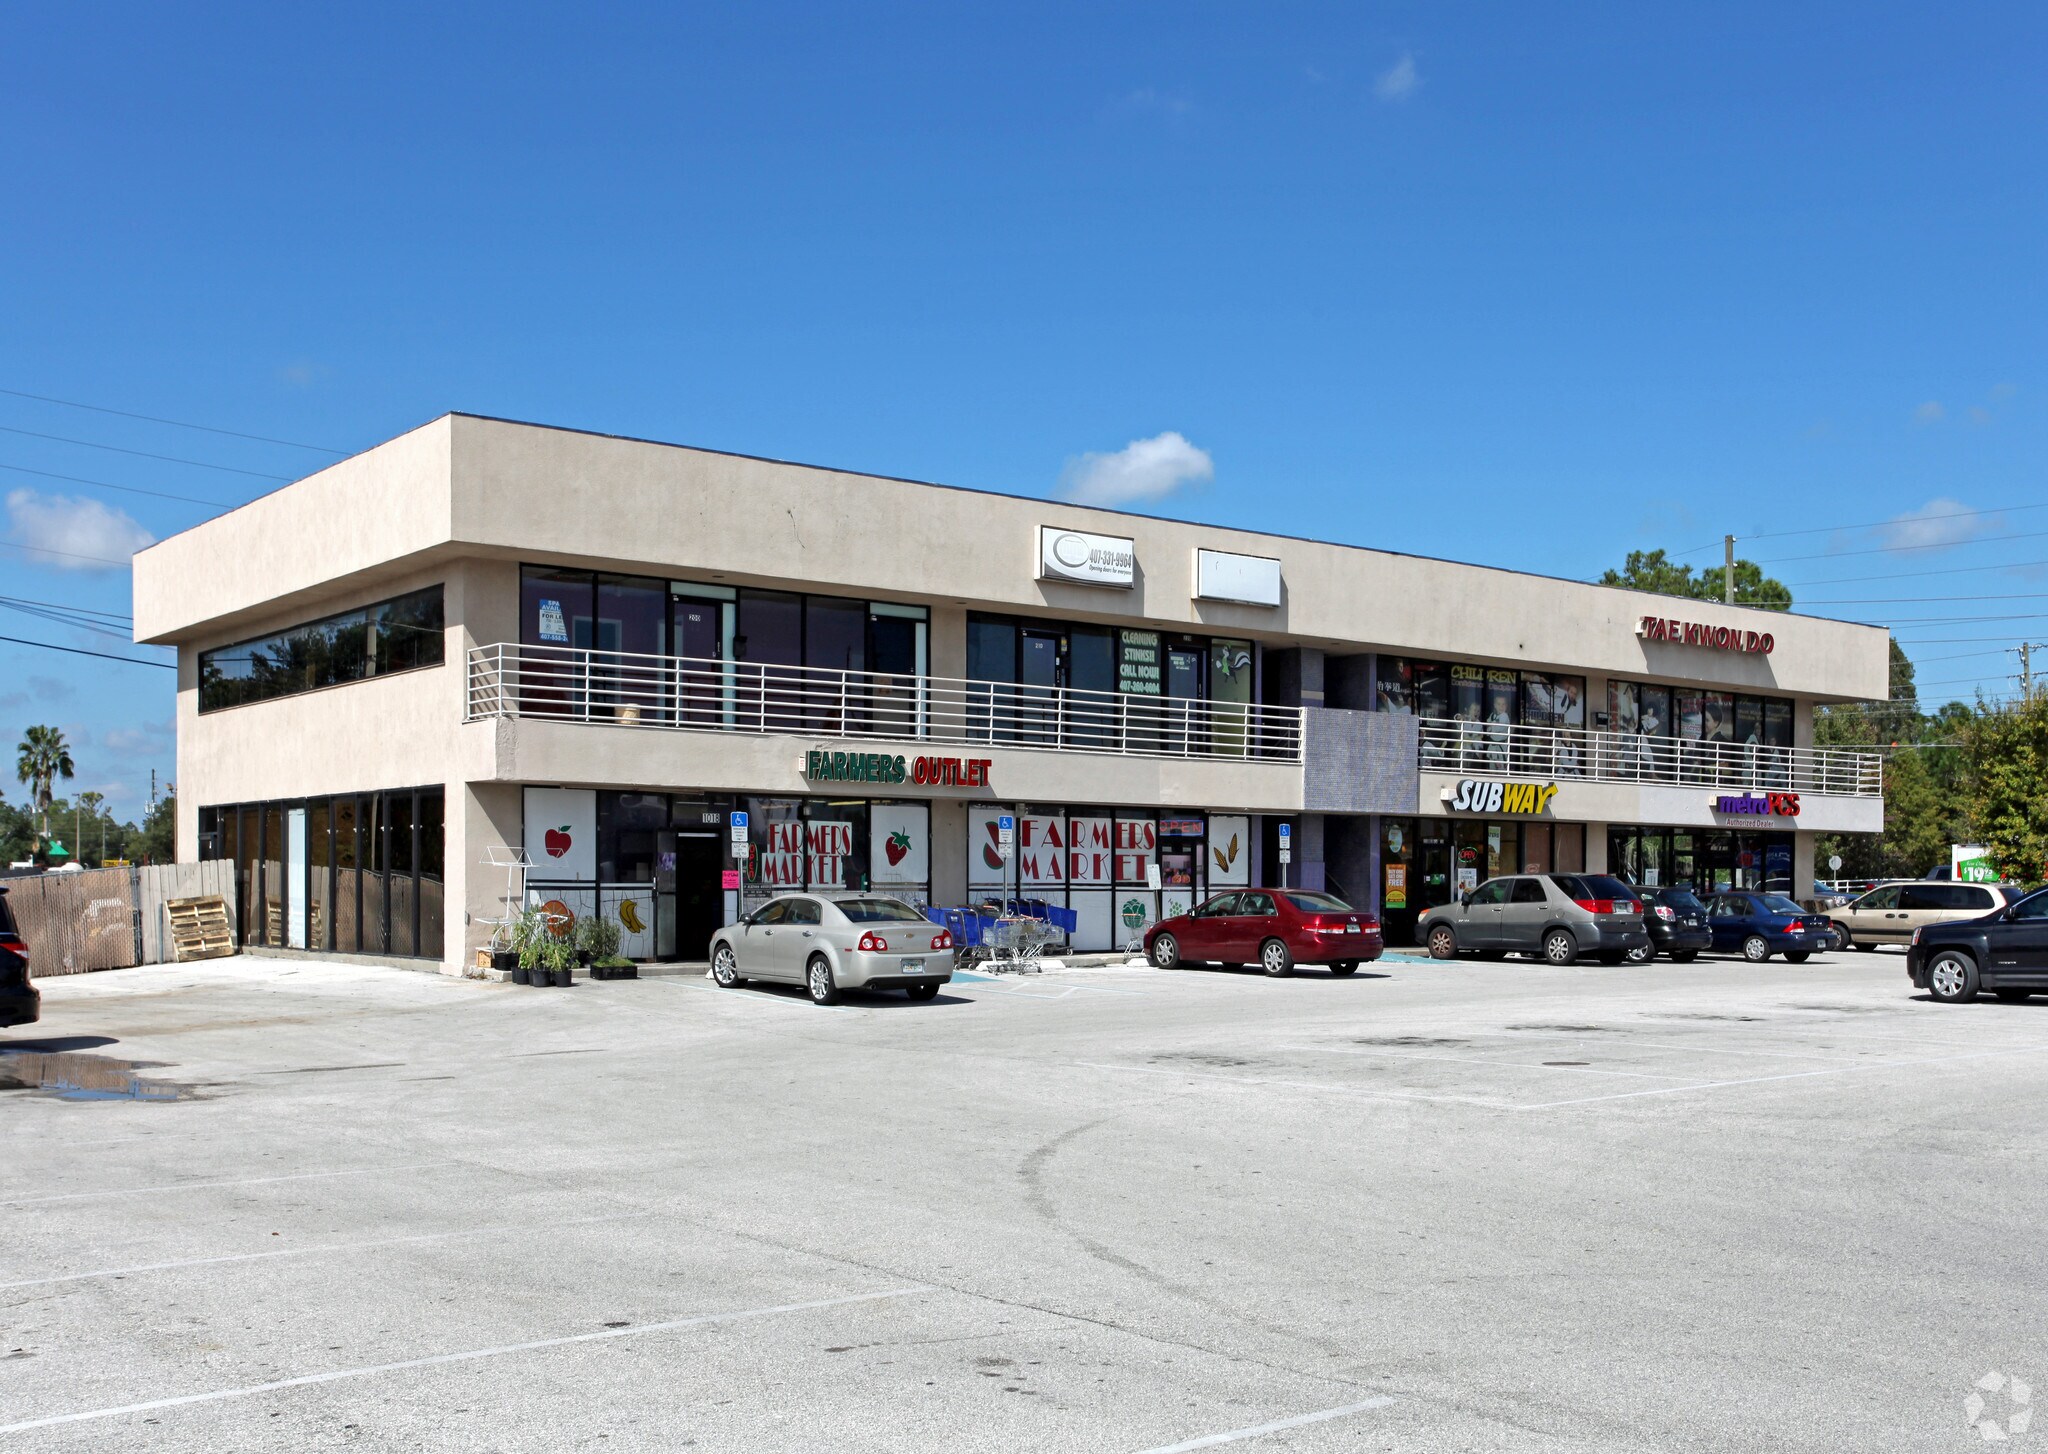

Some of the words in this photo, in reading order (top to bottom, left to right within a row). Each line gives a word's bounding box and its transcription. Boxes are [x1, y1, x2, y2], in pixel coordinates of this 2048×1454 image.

[1089, 548, 1131, 568] 407-331-9964
[1121, 631, 1158, 647] CLEANING
[1643, 615, 1681, 642] TAE
[1682, 622, 1742, 652] KWON
[1745, 630, 1775, 655] DO
[1124, 648, 1155, 663] STINKS!!
[1120, 664, 1137, 678] CALL
[1138, 665, 1160, 680] NOW!
[808, 750, 907, 784] FARMERS
[912, 755, 992, 788] OUTLET
[1452, 779, 1559, 814] SUBWAY
[1717, 792, 1800, 817] metroPCS
[1159, 821, 1202, 832] OPEN
[1727, 819, 1756, 827] Authorized
[1757, 820, 1774, 828] Dealer
[769, 823, 851, 856] FARMERS
[1021, 820, 1156, 850] FARMERS
[1460, 850, 1475, 859] OPEN
[764, 854, 840, 884] MARKET
[1020, 852, 1149, 881] MARKET
[1388, 879, 1404, 887] FREE
